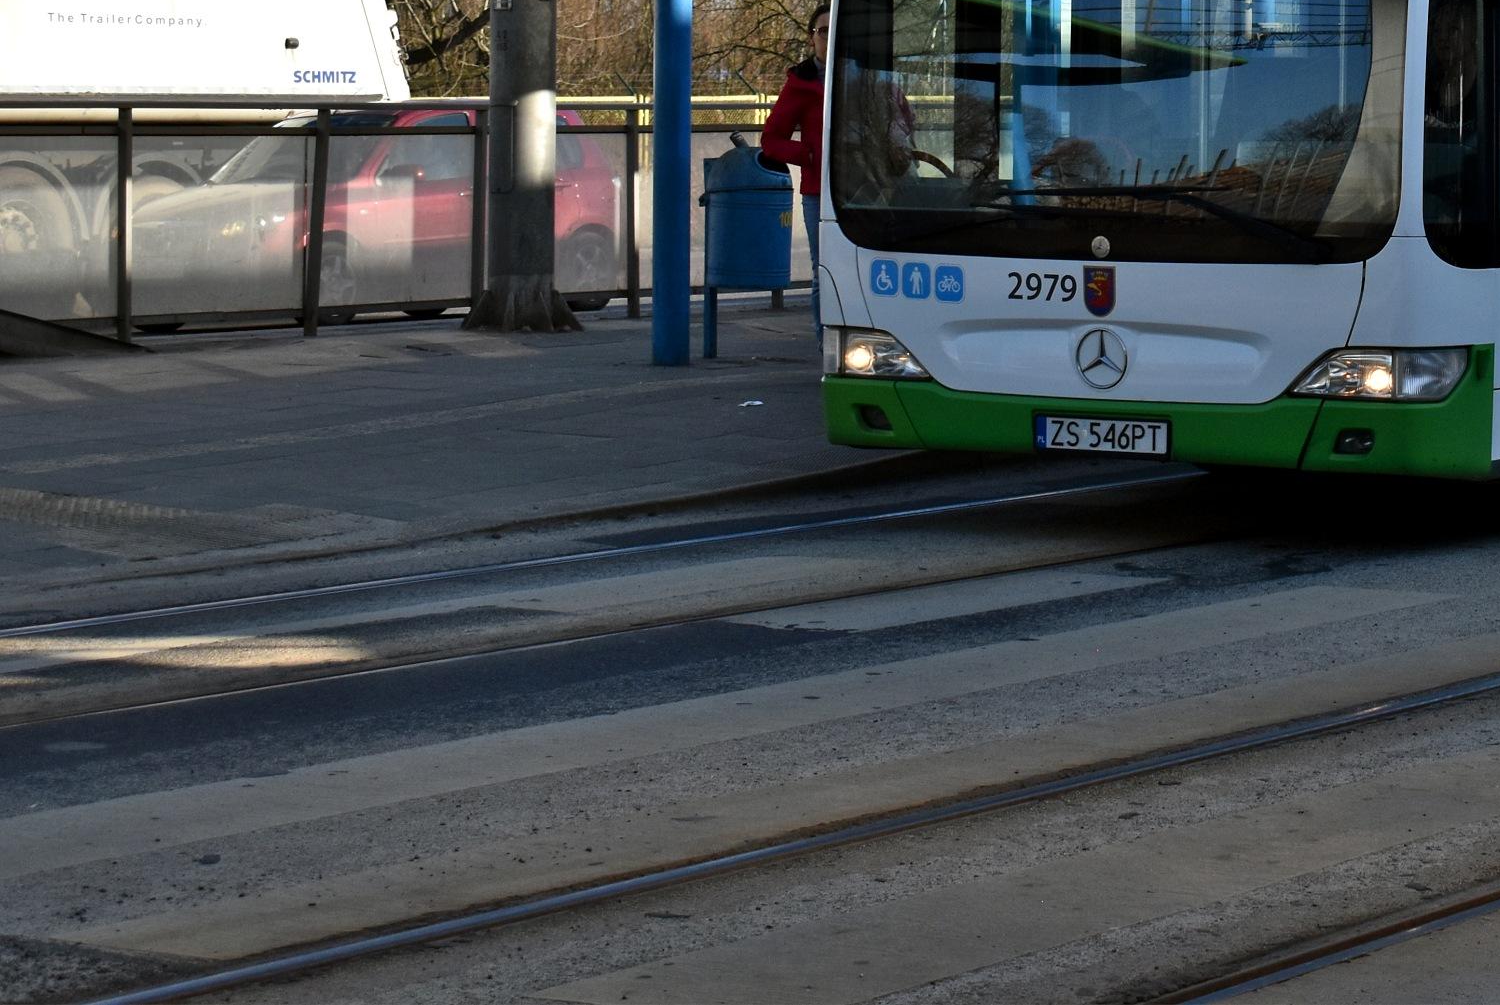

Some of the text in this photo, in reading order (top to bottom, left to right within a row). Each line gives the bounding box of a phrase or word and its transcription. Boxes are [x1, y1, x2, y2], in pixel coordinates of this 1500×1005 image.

[47, 12, 74, 23] The
[293, 70, 357, 85] SCHMITZ
[1007, 271, 1078, 302] 2979
[1037, 435, 1046, 444] PL
[1050, 420, 1162, 452] ZS 546PT
